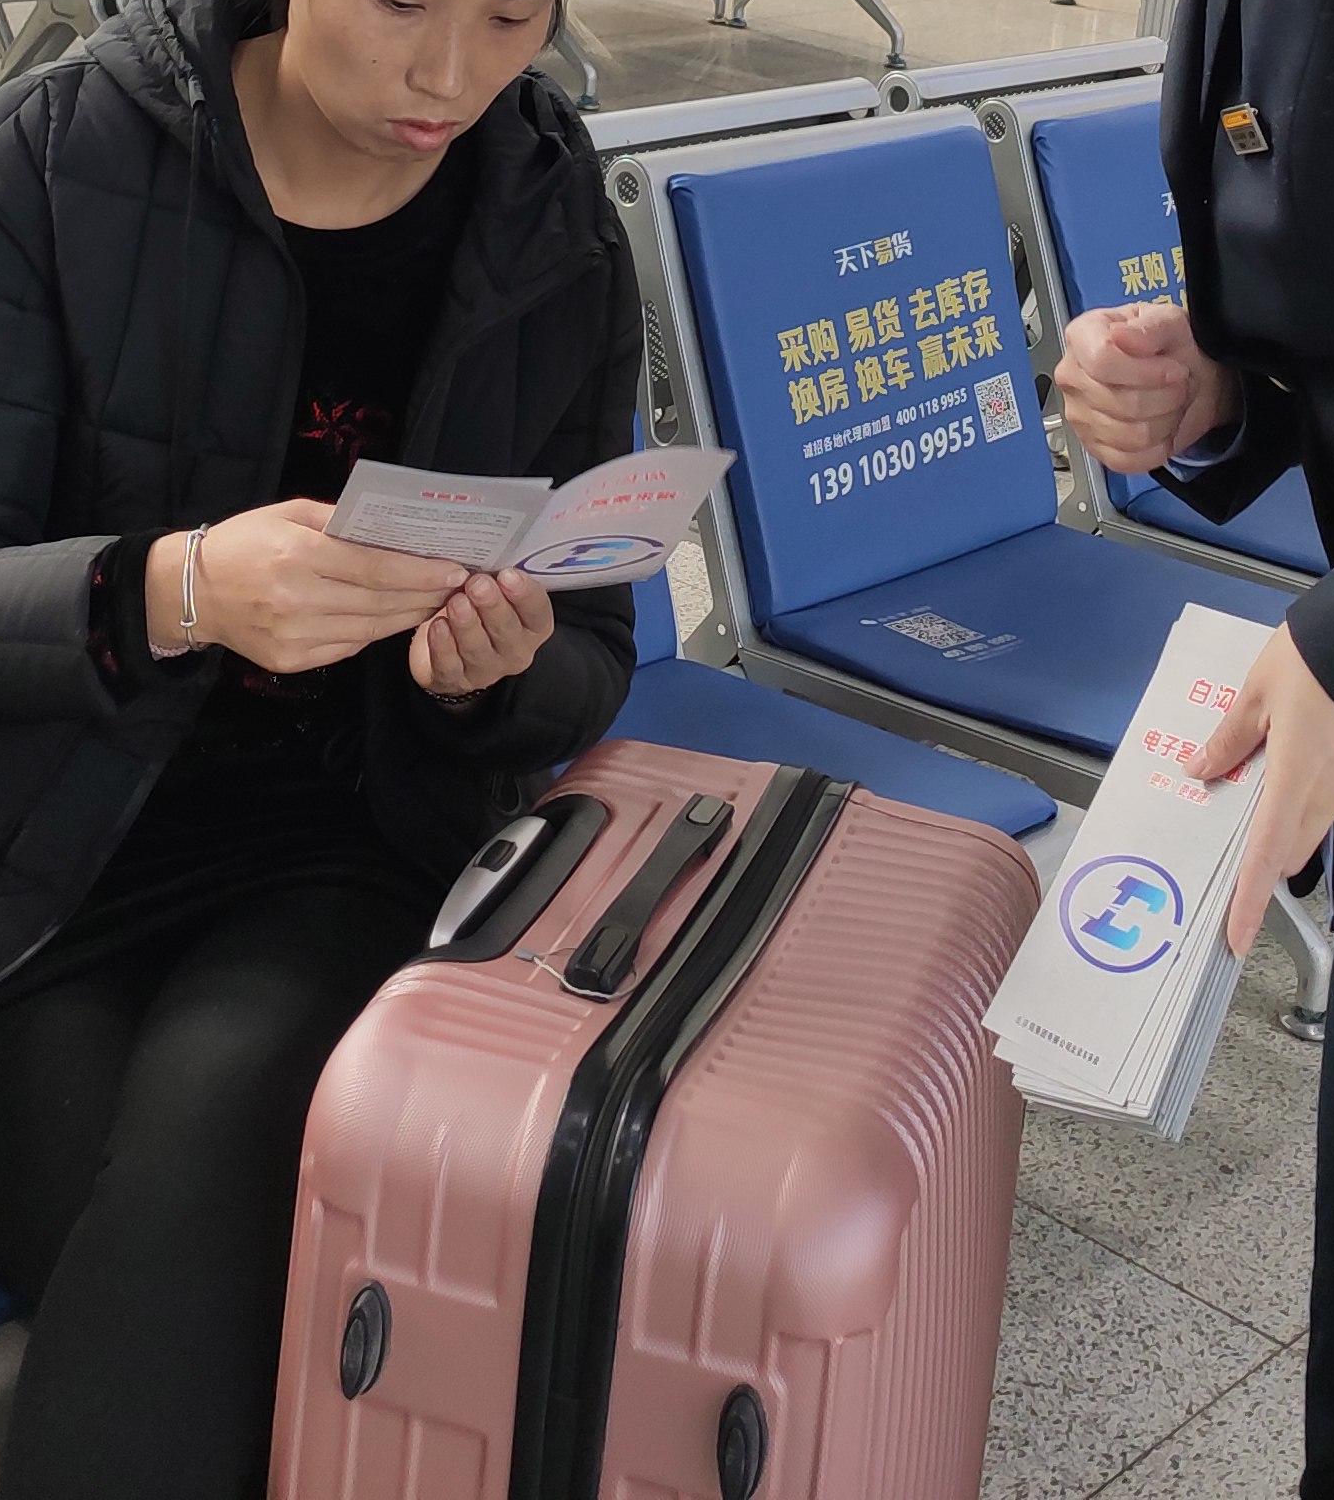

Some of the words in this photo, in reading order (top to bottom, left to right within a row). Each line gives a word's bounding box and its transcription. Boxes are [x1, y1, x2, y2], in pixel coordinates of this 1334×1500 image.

[833, 230, 912, 277] 天下易货
[1118, 251, 1168, 296] 采购
[777, 318, 840, 373] 采购
[844, 296, 905, 354] 易货
[908, 268, 992, 331] 去库存
[788, 367, 850, 426] 换房
[854, 347, 915, 403] 换车
[917, 315, 1003, 381] 赢未来
[802, 414, 892, 459] 诚招各地代理商加盟
[895, 405, 917, 426] 400
[918, 396, 939, 419] 118
[940, 387, 968, 412] 9955
[809, 462, 854, 506] 139
[858, 439, 916, 486] 1030
[919, 416, 976, 464] 9955
